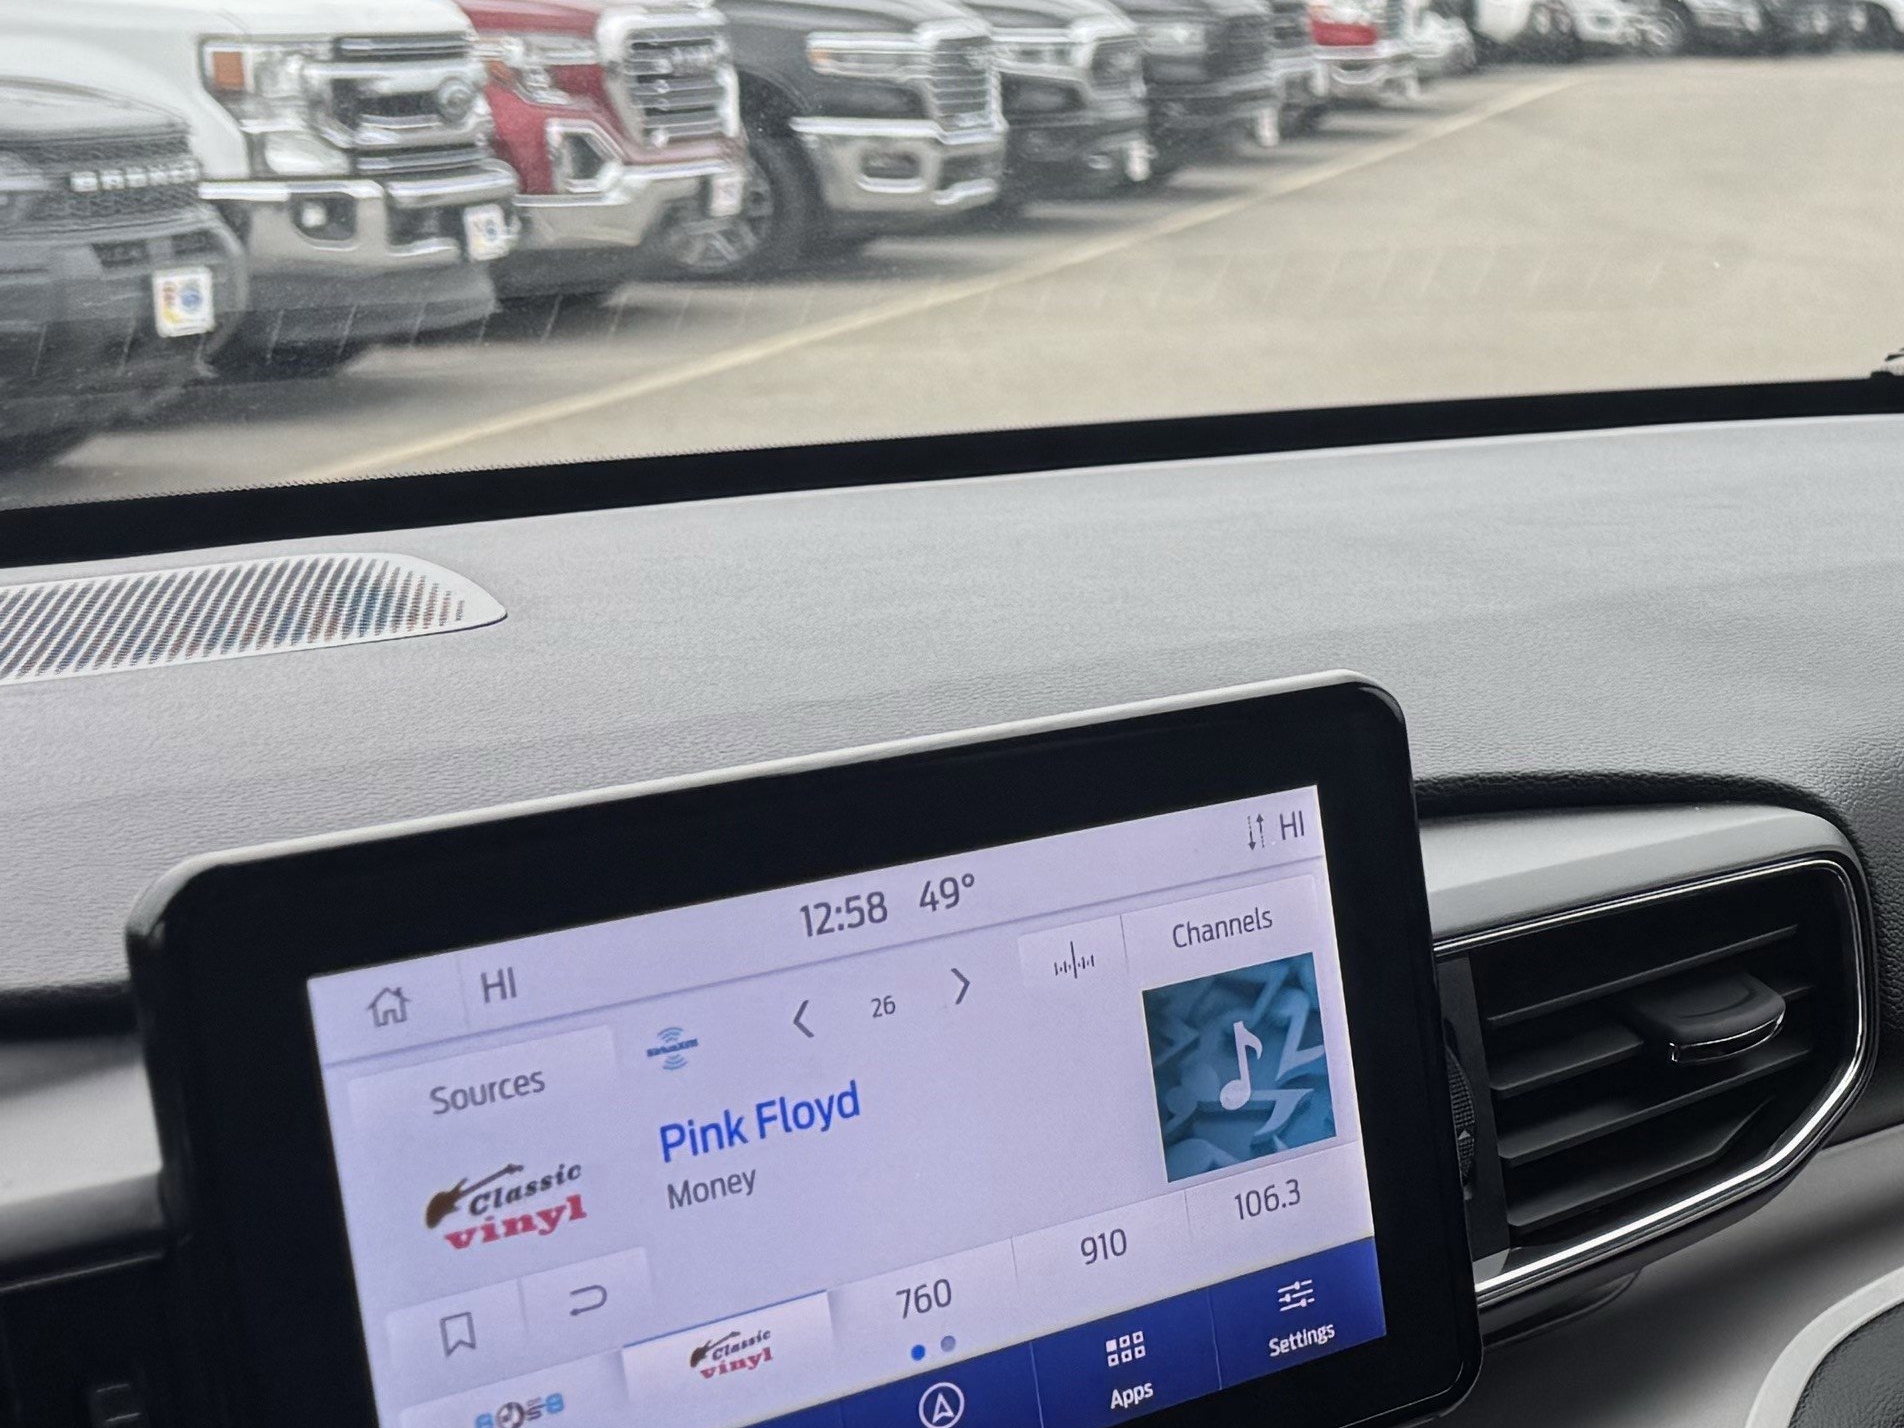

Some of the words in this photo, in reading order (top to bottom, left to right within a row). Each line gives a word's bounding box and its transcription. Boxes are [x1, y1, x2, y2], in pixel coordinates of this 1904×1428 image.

[1278, 810, 1305, 842] HI
[799, 890, 889, 938] 12:58
[917, 872, 976, 913] 49°
[1171, 905, 1274, 950] Channels
[480, 966, 518, 1005] HI
[870, 994, 897, 1019] 26
[428, 1070, 547, 1116] Sources
[659, 1109, 750, 1163] Pink
[756, 1079, 862, 1140] Floyd
[468, 1162, 583, 1217] Classic
[666, 1168, 758, 1211] Money
[1233, 1177, 1302, 1221] 106.3
[1080, 1227, 1128, 1265] 910
[895, 1277, 953, 1320] 760
[711, 1329, 772, 1362] Classic
[1268, 1321, 1336, 1359] Settings
[1109, 1379, 1154, 1410] Apps
